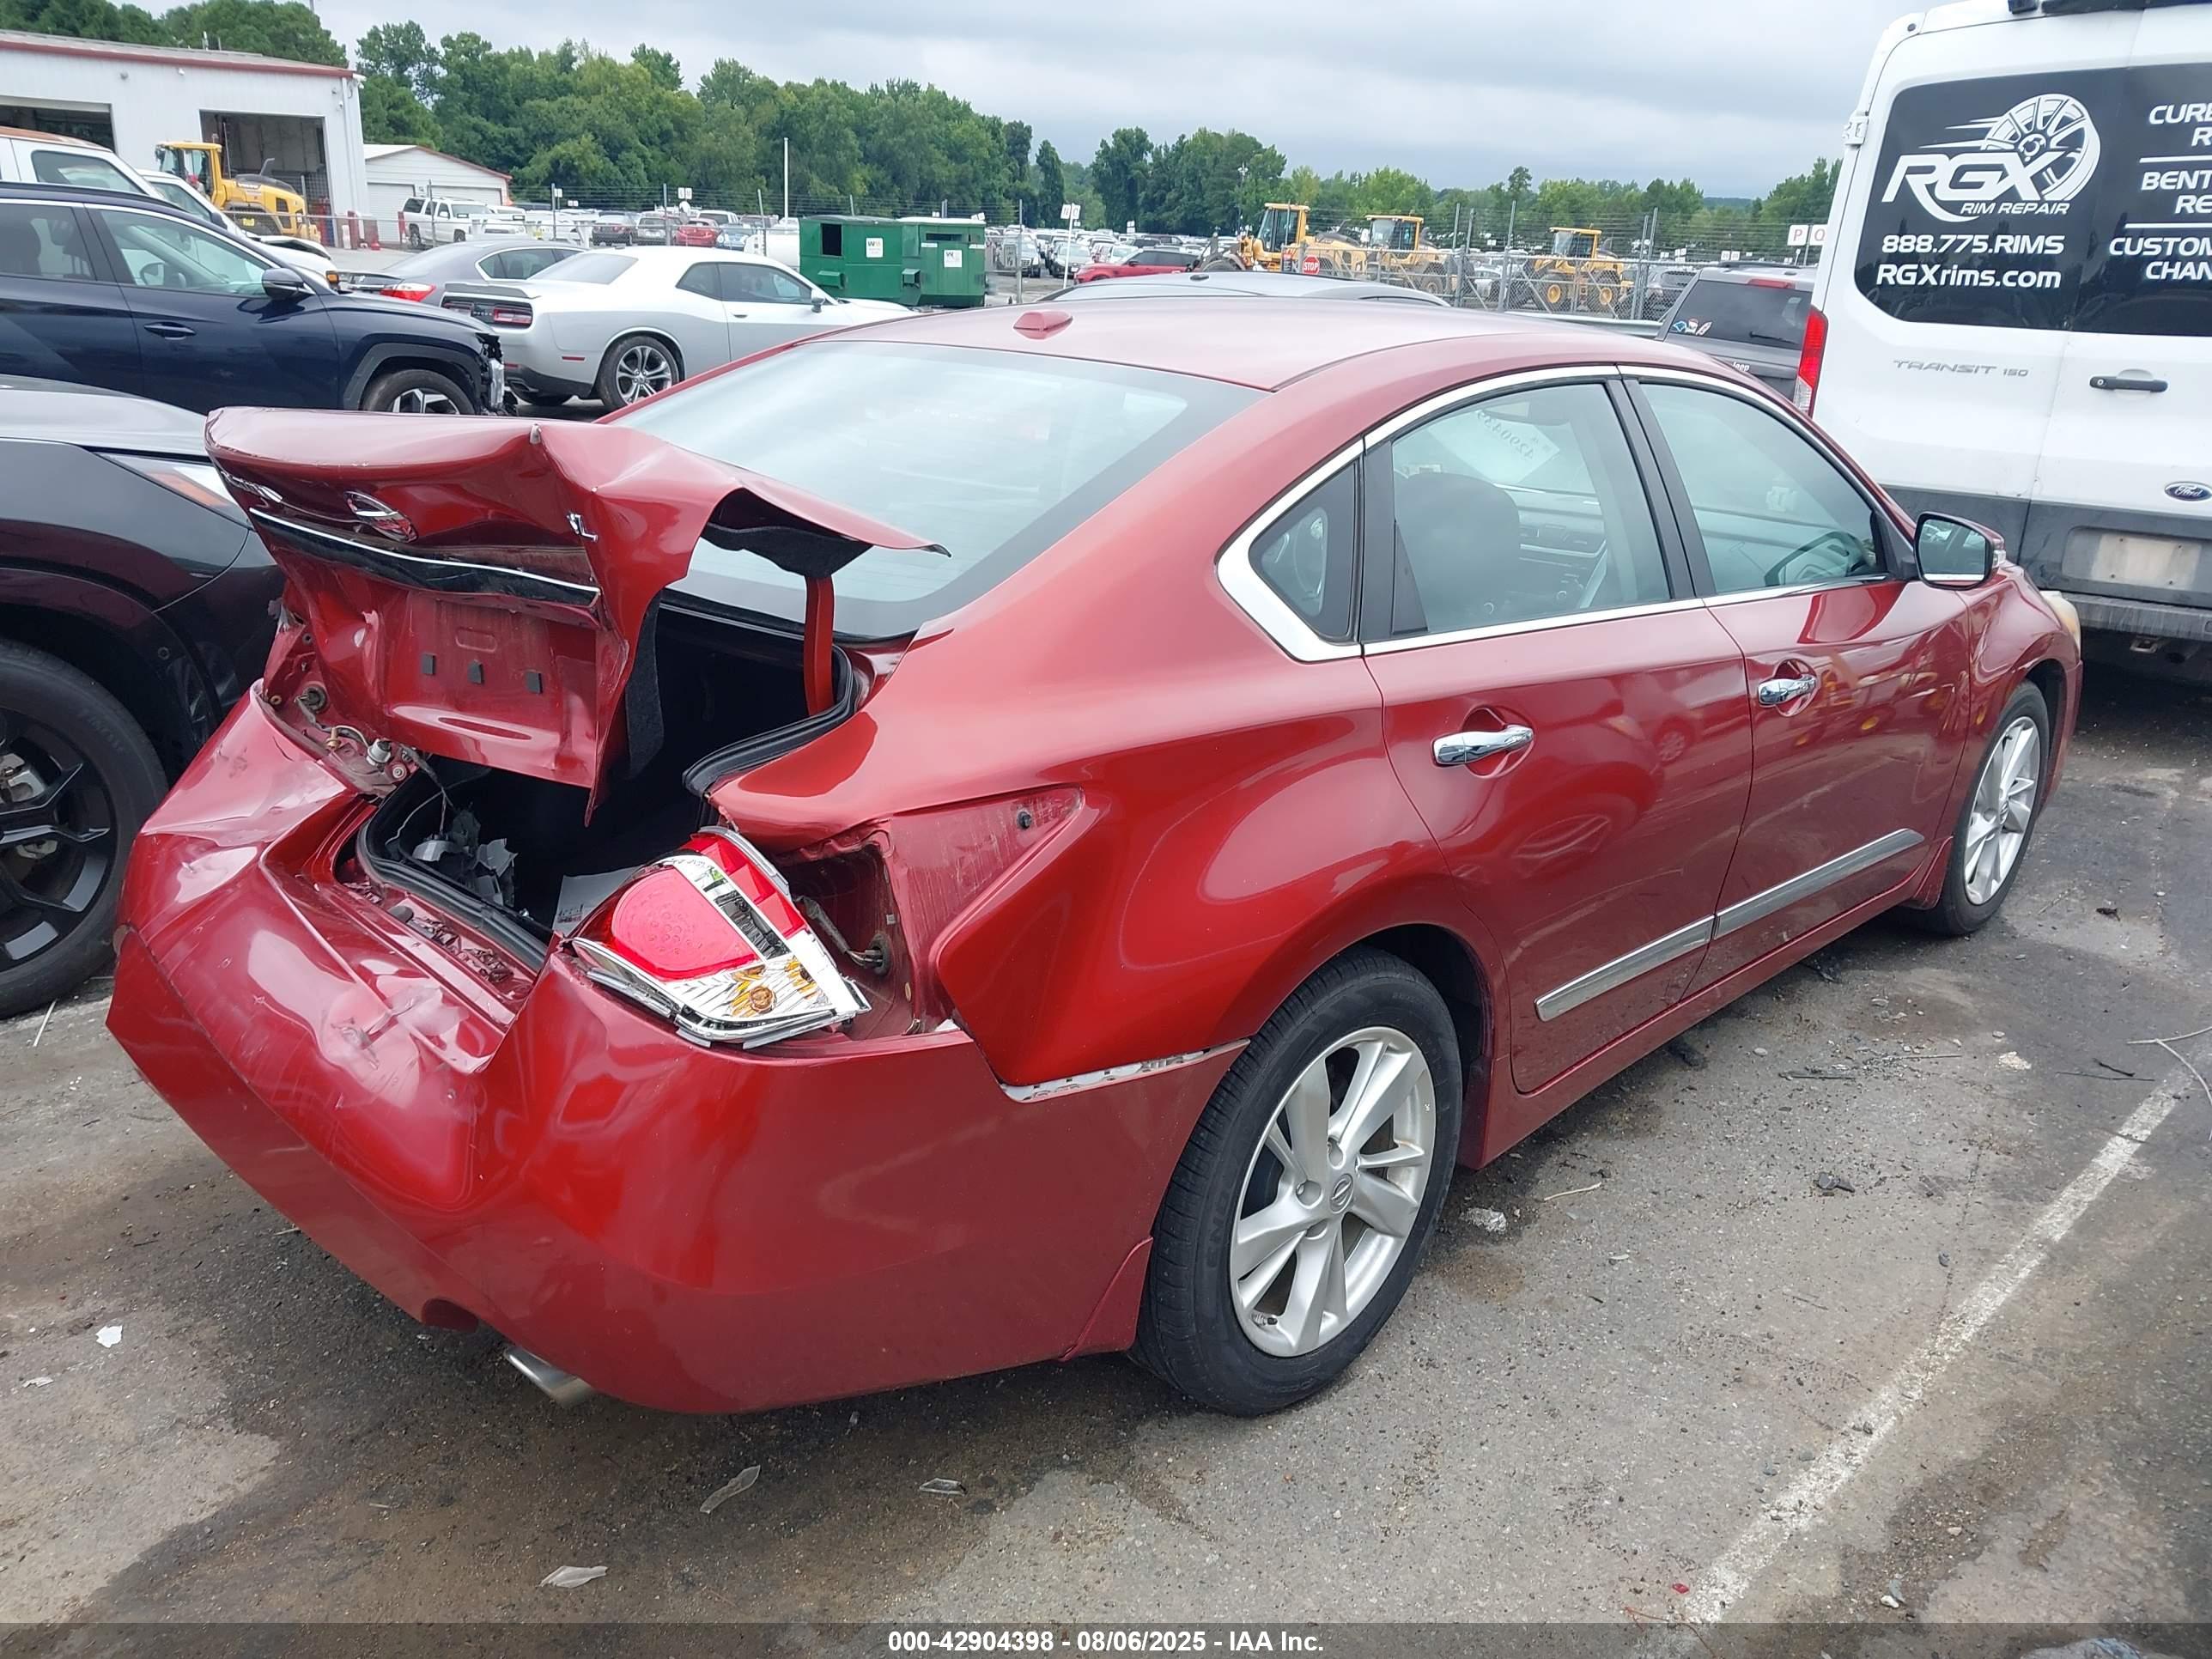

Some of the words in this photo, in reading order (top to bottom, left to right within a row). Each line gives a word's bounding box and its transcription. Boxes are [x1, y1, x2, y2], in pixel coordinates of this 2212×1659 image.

[1881, 151, 2065, 222] RGX
[2141, 169, 2212, 191] BENT
[1960, 203, 1996, 215] RIM
[1998, 202, 2070, 215] REPAIR
[1793, 228, 1803, 241] P
[1881, 234, 2065, 254] 888.775.RIMS
[1304, 262, 1319, 271] STOP
[2146, 260, 2212, 281] CHAN
[1876, 264, 2061, 289] RGXrims.com
[1893, 359, 1997, 374] TRANSIT
[2002, 368, 2029, 377] 150
[2174, 483, 2203, 496] Ford
